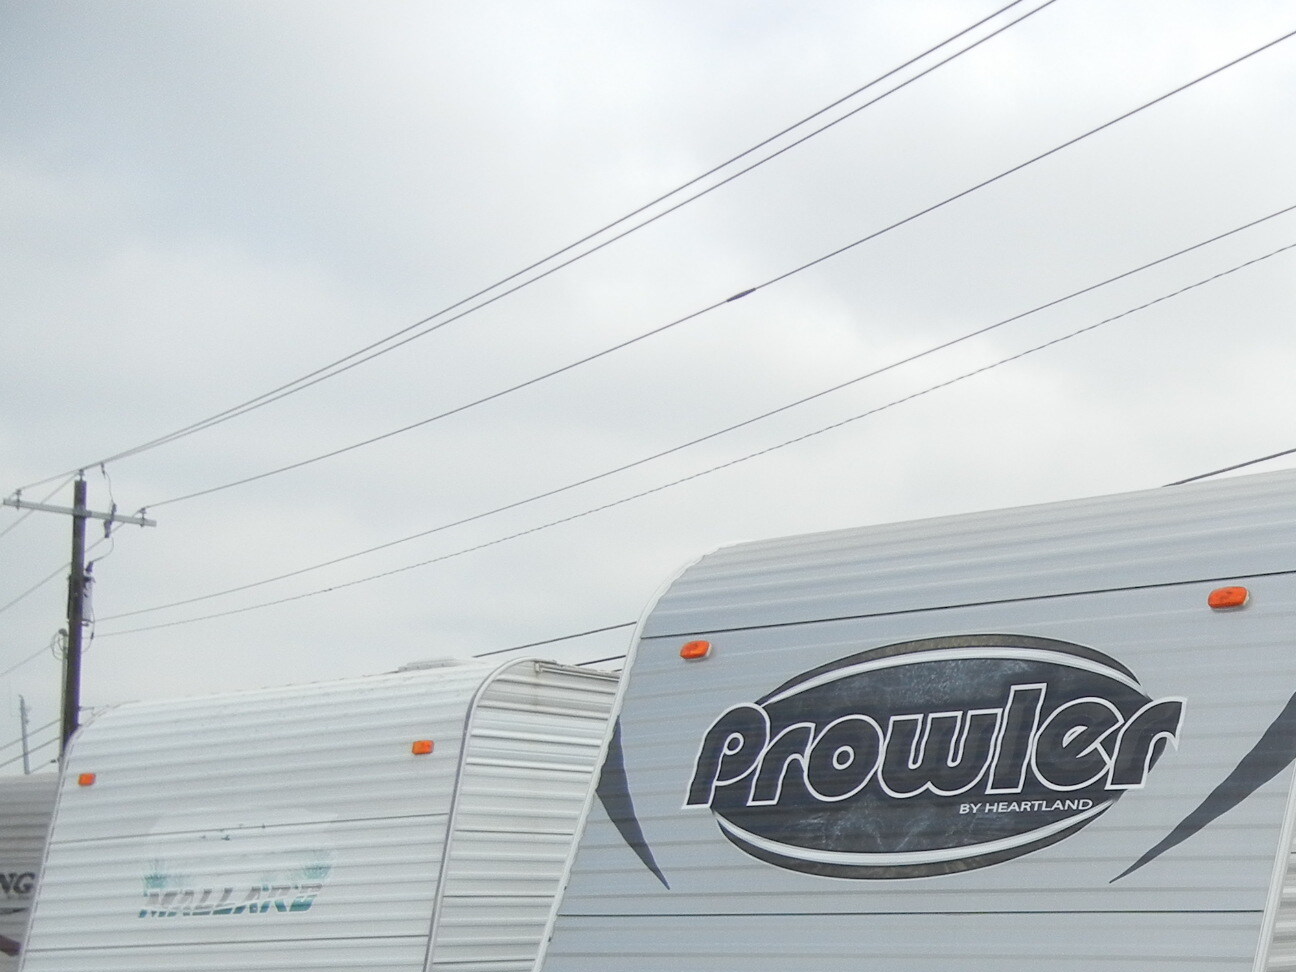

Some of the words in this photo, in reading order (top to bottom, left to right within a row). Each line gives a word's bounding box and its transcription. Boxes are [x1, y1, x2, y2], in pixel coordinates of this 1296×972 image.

[683, 683, 1186, 809] Prowler
[959, 803, 982, 814] BY
[984, 799, 1093, 813] HEARTLAND
[138, 884, 323, 918] MALLARD
